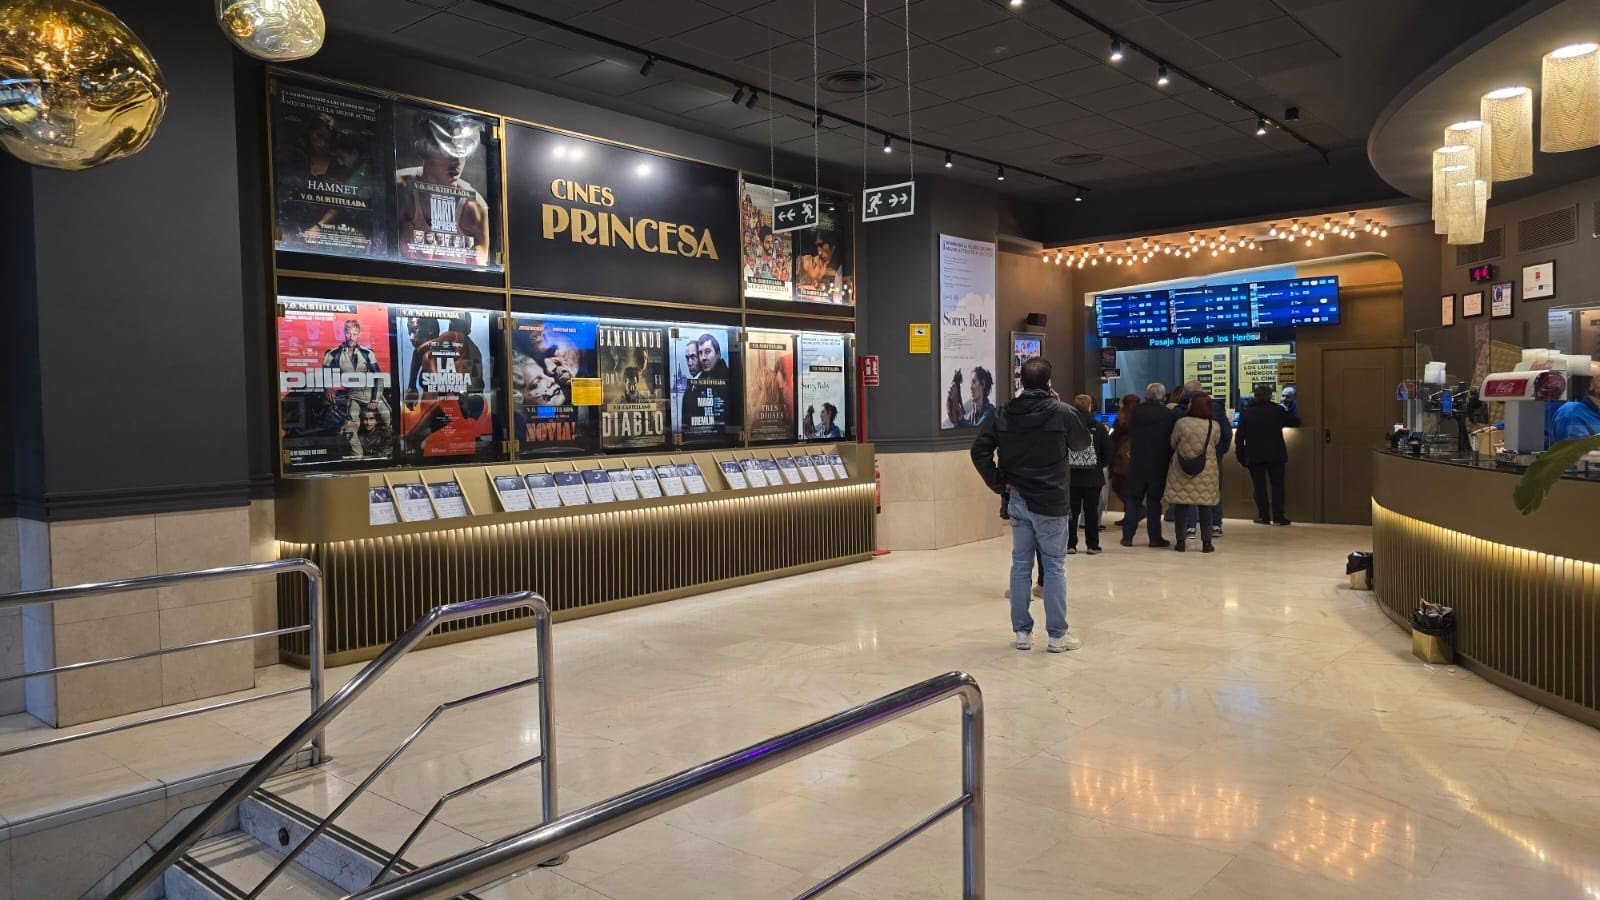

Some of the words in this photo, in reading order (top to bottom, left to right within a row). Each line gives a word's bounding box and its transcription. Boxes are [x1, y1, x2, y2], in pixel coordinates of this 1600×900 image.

[308, 180, 359, 196] HAMNET
[551, 178, 615, 207] CINES
[315, 195, 367, 208] SUBTITULADA
[430, 198, 456, 221] MARTY
[542, 203, 719, 260] PRINCESA
[300, 303, 351, 312] SUBTITULADA
[944, 311, 968, 331] Sorry,
[969, 312, 989, 333] Baby
[600, 329, 661, 348] CAMINANDO
[1149, 337, 1174, 347] Pasaje
[1177, 335, 1201, 345] Martín
[1203, 335, 1214, 343] de
[436, 357, 456, 373] LA
[280, 366, 392, 393] pillion
[421, 372, 472, 386] SOMBRA
[428, 385, 436, 393] DE
[437, 385, 445, 393] MI
[446, 384, 468, 393] PADRE
[706, 387, 713, 398] EL
[697, 397, 714, 408] MAGO
[761, 404, 779, 412] TRES
[704, 406, 715, 417] DEL
[760, 412, 784, 420] DIOSES
[602, 410, 664, 437] DIABLO
[691, 415, 715, 426] KREMLIN
